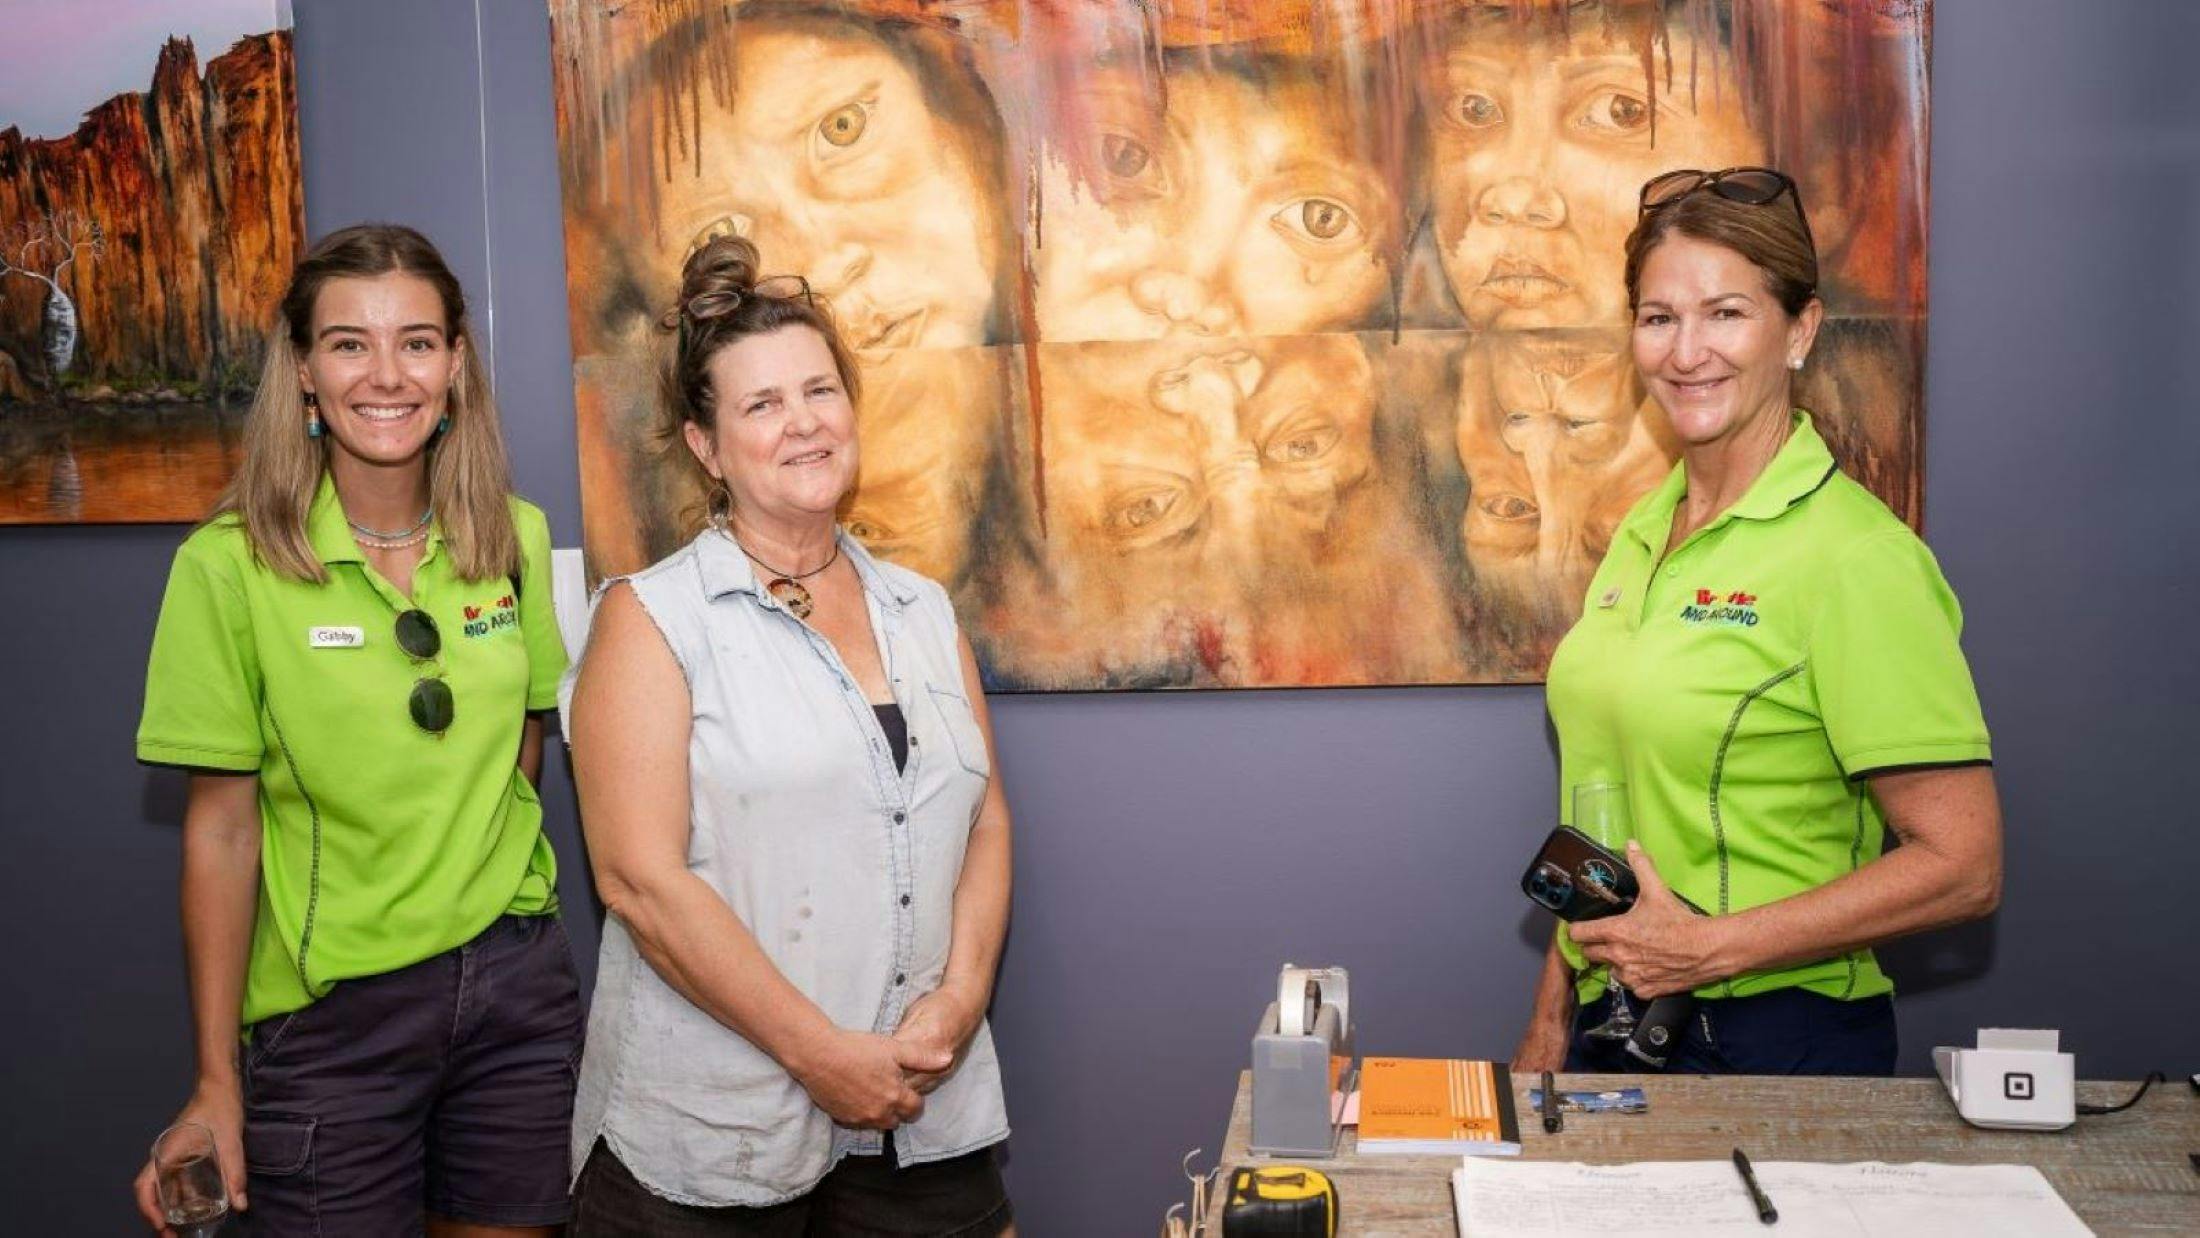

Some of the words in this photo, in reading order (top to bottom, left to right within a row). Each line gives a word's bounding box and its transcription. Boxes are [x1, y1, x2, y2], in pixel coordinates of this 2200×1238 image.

[1680, 606, 1707, 621] AND
[318, 630, 354, 643] Gabby
[464, 622, 488, 637] AND
